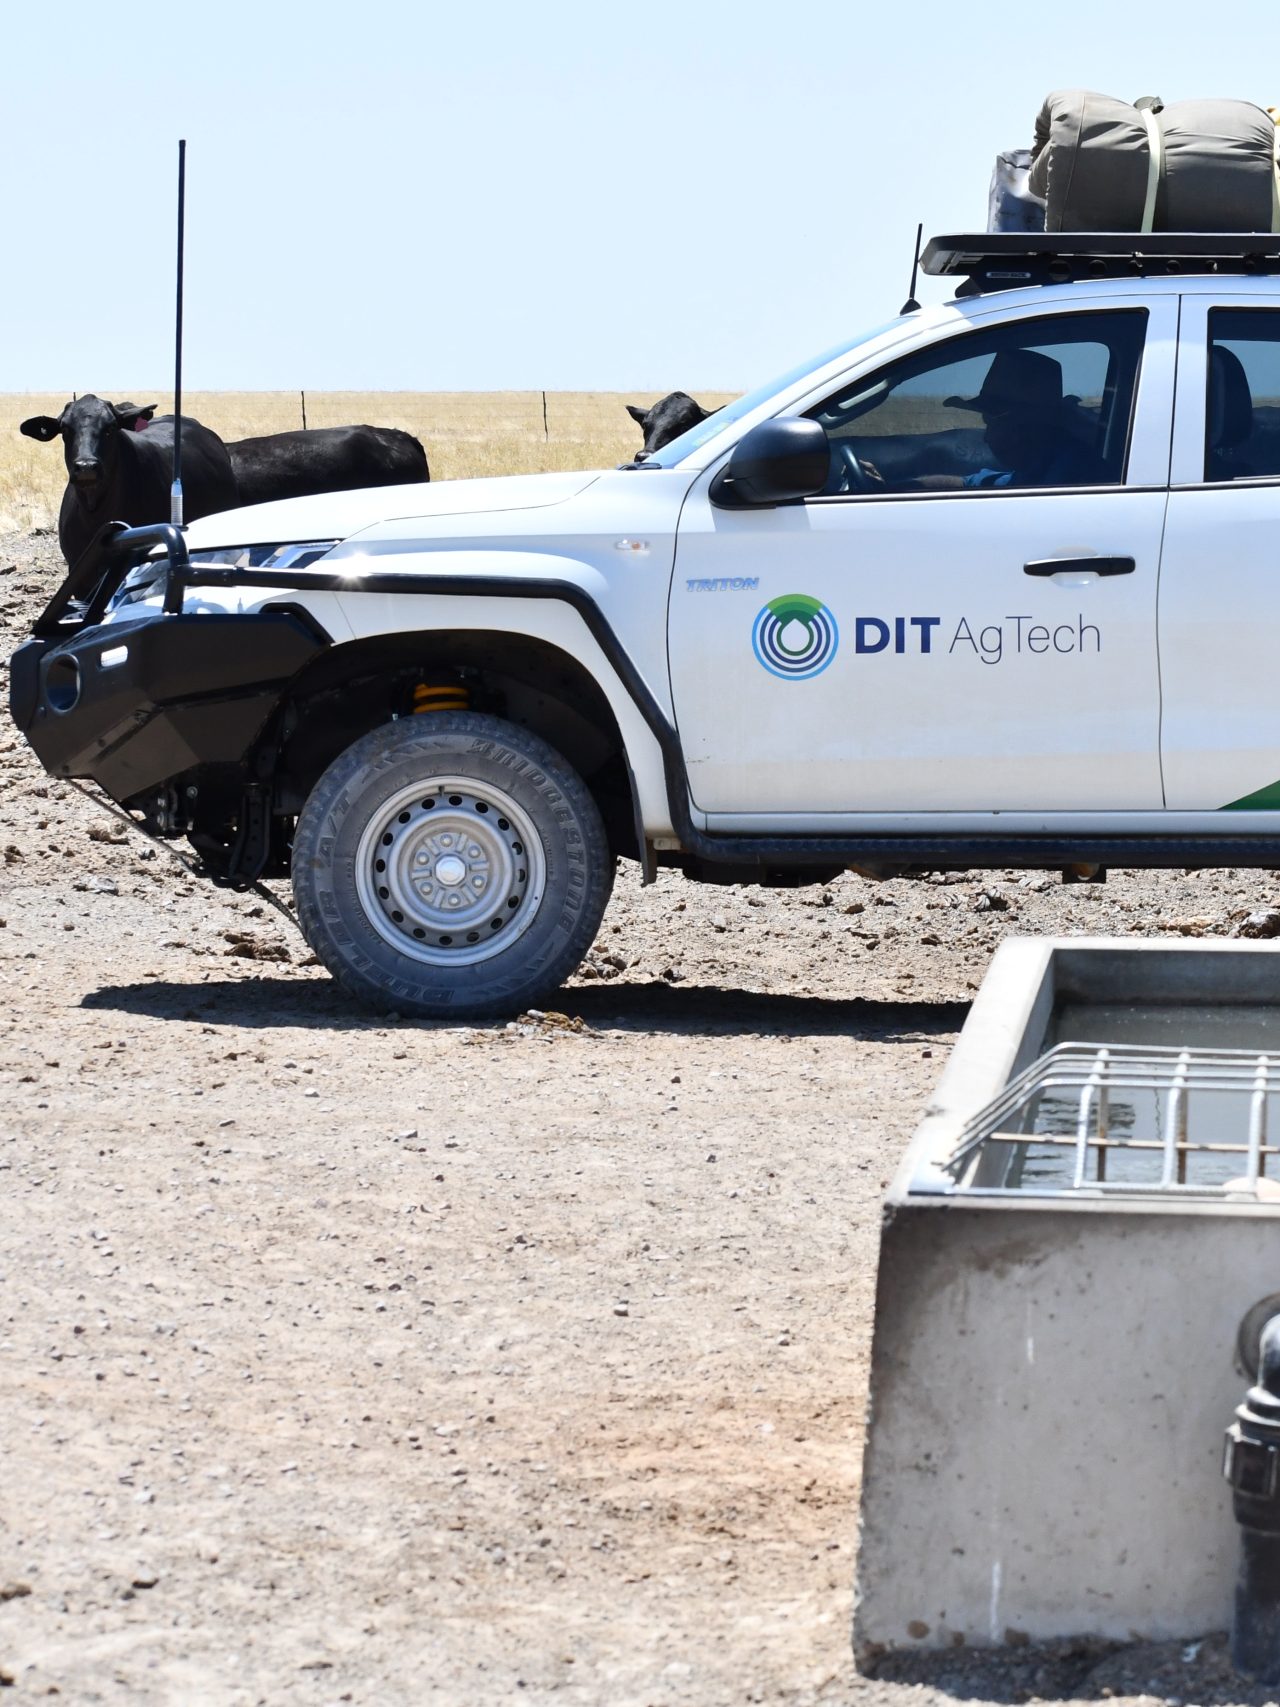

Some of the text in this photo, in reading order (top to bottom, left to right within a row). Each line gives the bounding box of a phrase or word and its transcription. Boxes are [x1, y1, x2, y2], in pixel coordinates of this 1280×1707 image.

[686, 577, 760, 592] TRITON
[855, 613, 1101, 665] DIT AgTech
[318, 788, 353, 862] A/T
[466, 738, 585, 933] BRIDGESTONE
